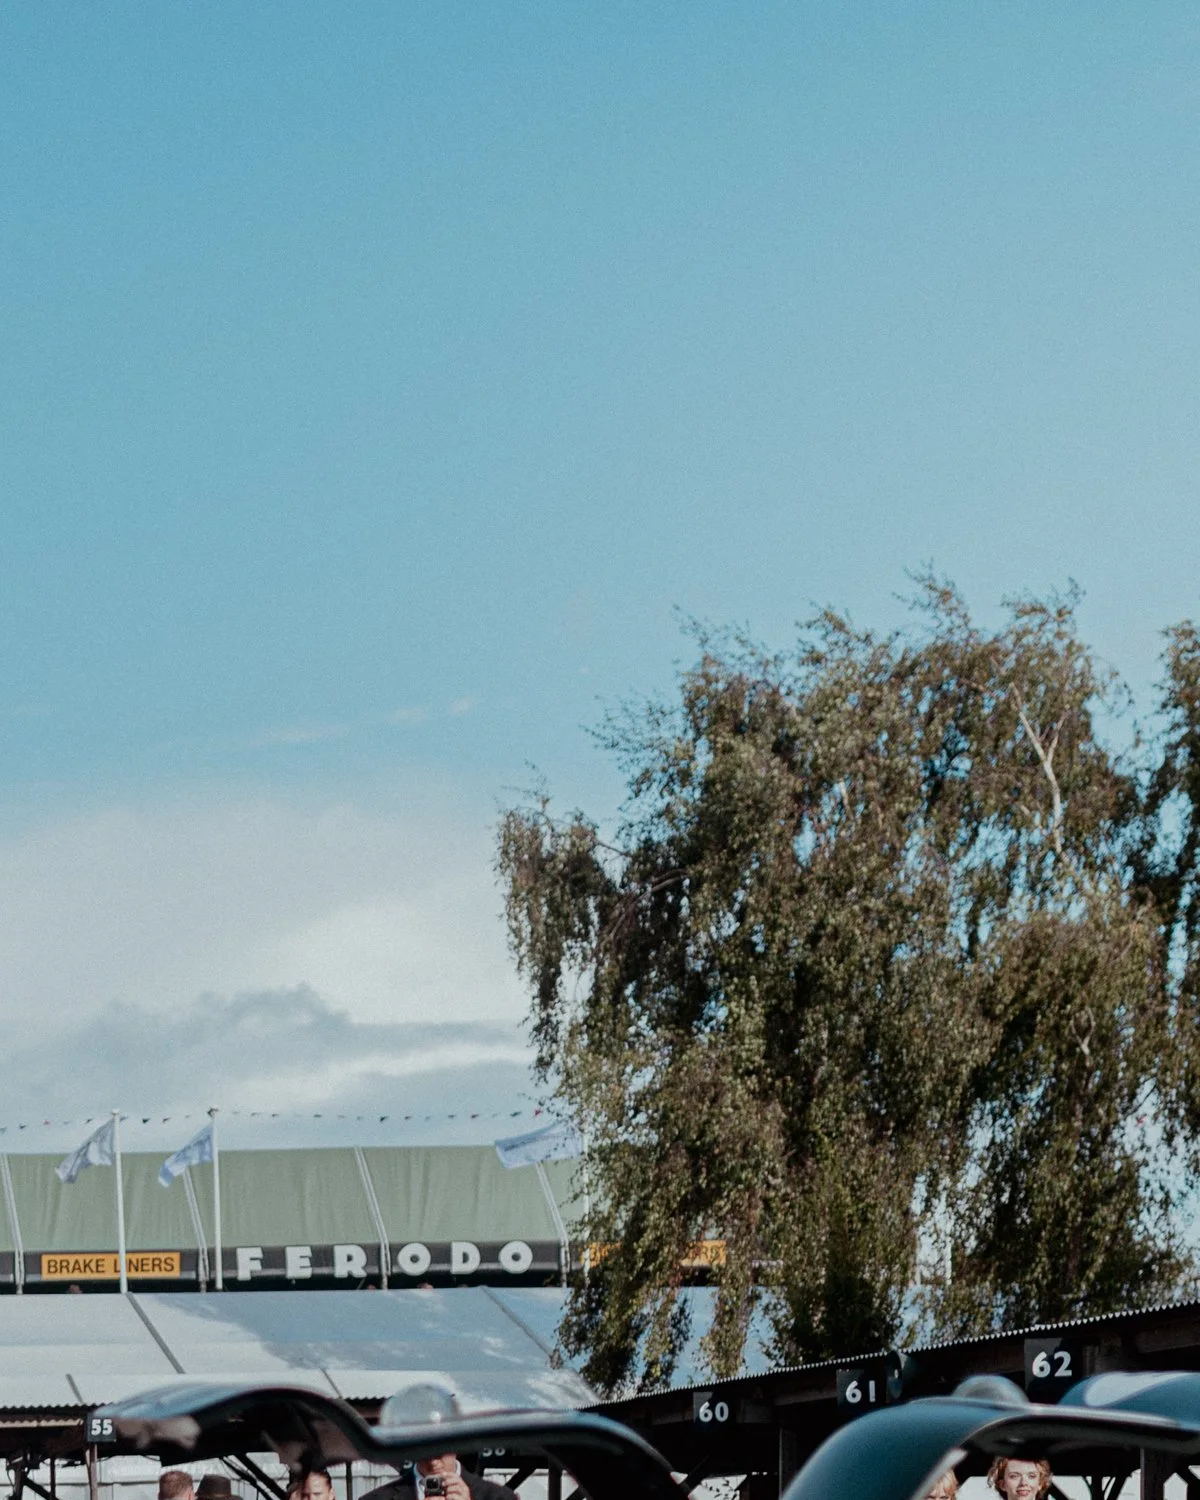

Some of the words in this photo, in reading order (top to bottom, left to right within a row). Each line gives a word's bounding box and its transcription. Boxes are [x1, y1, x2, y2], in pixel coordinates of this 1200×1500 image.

[46, 1258, 105, 1274] BRAKE
[113, 1256, 175, 1273] LNERS
[236, 1240, 533, 1281] FERODO
[1031, 1351, 1073, 1379] 62
[845, 1380, 876, 1403] 61
[699, 1401, 729, 1423] 60
[91, 1418, 113, 1436] 55
